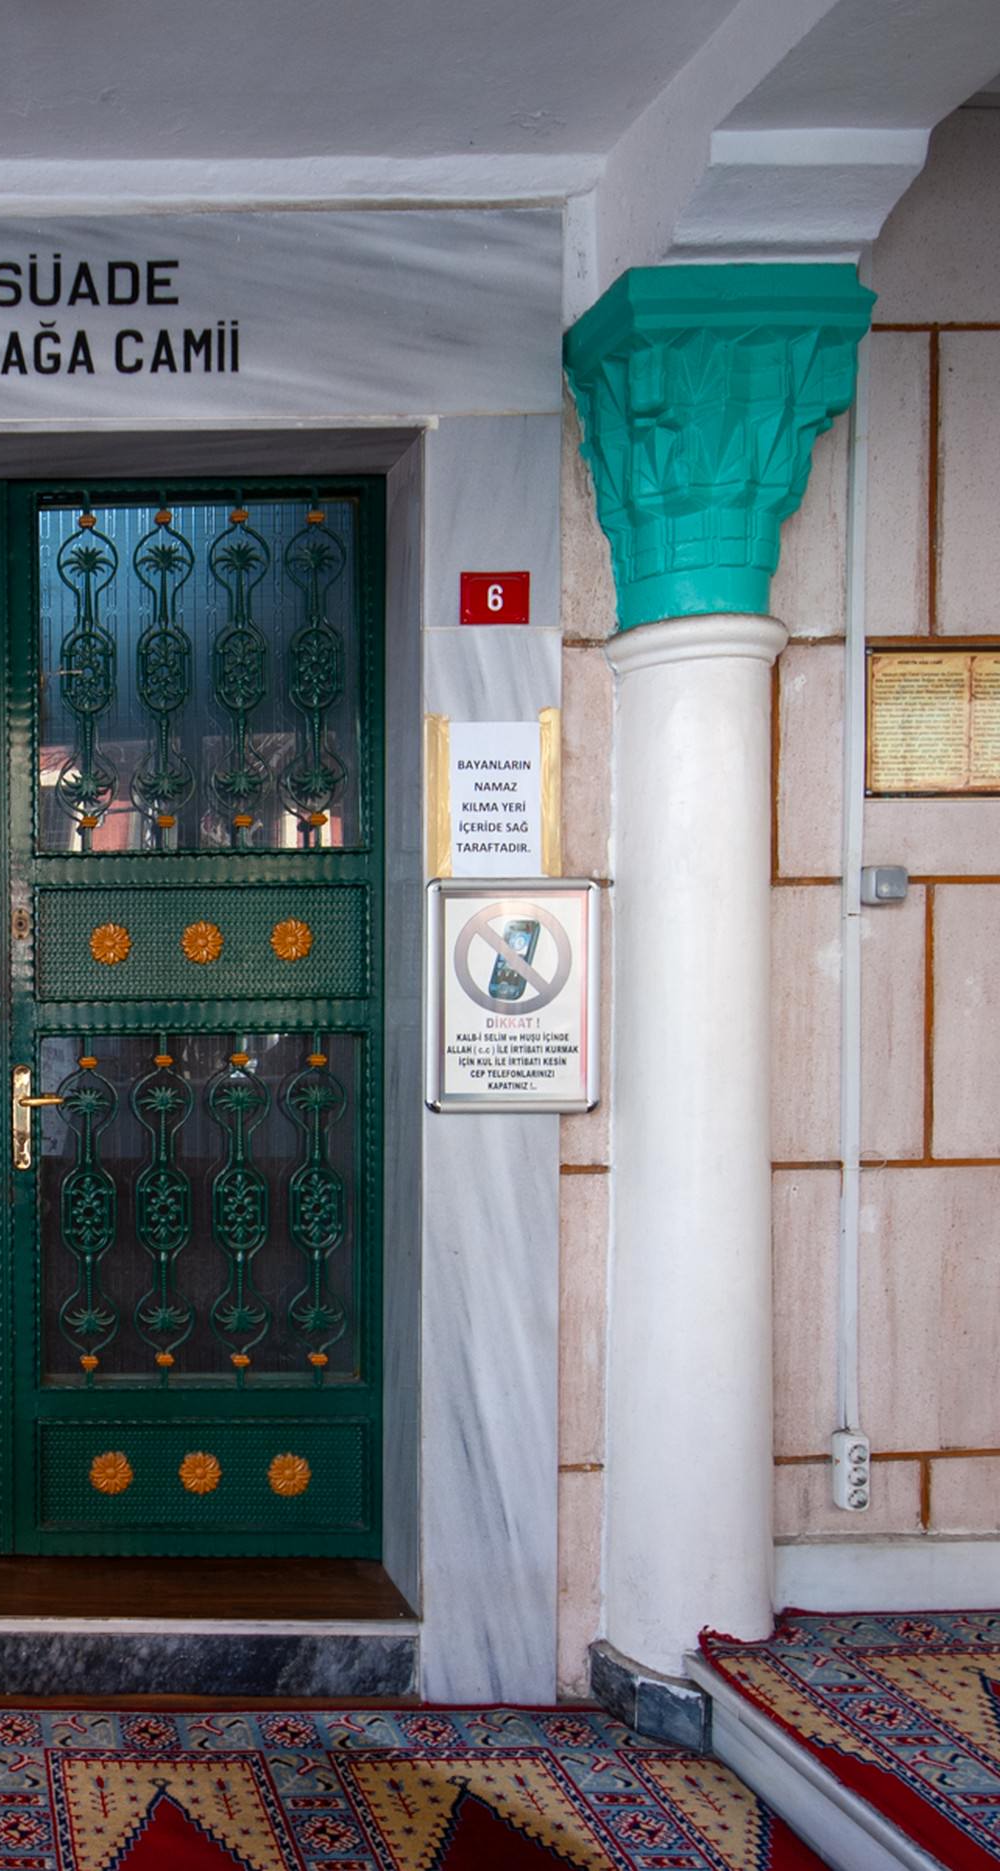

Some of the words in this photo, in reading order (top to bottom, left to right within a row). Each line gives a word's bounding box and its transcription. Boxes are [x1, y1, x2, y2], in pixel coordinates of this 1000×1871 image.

[0, 321, 95, 375] AĞA
[114, 320, 239, 374] CAMİİ
[488, 584, 503, 611] 6
[457, 760, 531, 770] BAYANLARIN
[474, 782, 517, 792] NAMAZ
[462, 803, 498, 812] KILMA
[502, 802, 525, 812] YERİ
[459, 821, 502, 834] İÇERİDE
[506, 822, 528, 832] SAĞ
[456, 843, 531, 852] TARAFTADIR.
[486, 1018, 533, 1028] DİKKAT
[484, 1033, 506, 1041] SELİM
[520, 1034, 540, 1042] HUŞU
[543, 1032, 569, 1042] İÇİNDE
[447, 1046, 472, 1054] ALLAH
[497, 1045, 508, 1054] İLE
[511, 1045, 543, 1054] İRTİBATI
[545, 1046, 578, 1054] KURMAK
[459, 1057, 474, 1067] İÇİN
[477, 1058, 492, 1066] KUL
[495, 1057, 506, 1066] İLE
[509, 1057, 541, 1066] İRTİBATI
[543, 1057, 566, 1066] KESİN
[470, 1070, 485, 1078] CEP
[488, 1070, 555, 1078] TELEFONLARINIZI
[488, 1082, 528, 1090] KAPATINIZ
